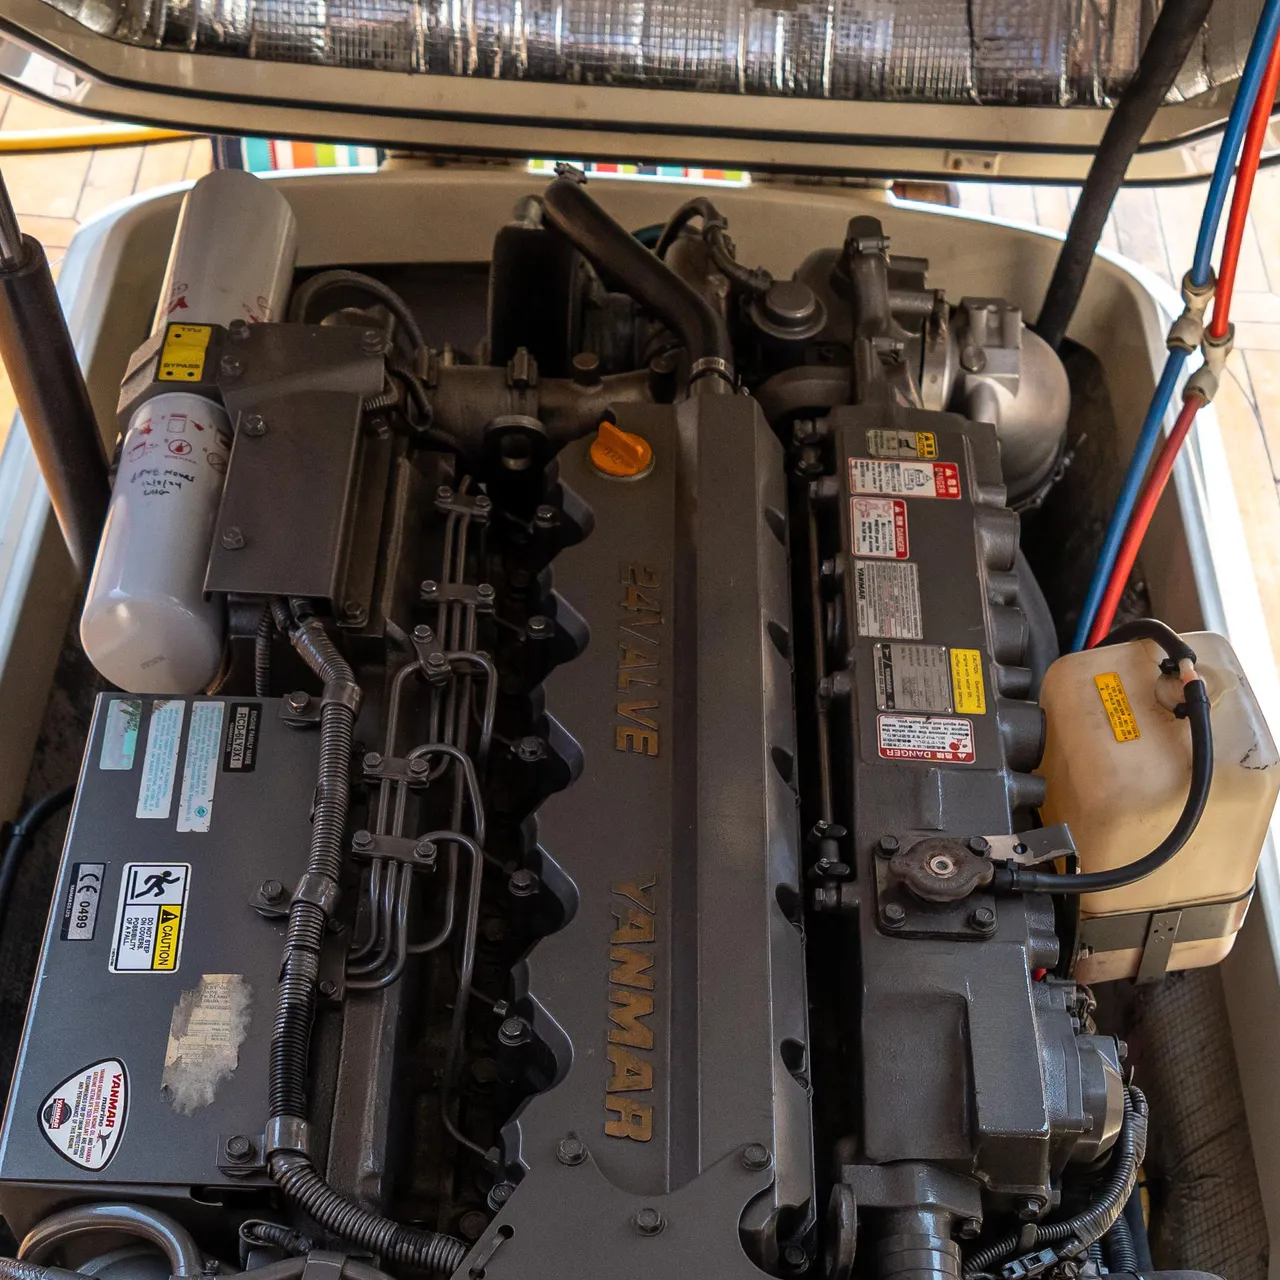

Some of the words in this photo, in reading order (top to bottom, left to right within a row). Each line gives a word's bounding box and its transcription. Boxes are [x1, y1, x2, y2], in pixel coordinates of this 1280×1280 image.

[934, 467, 945, 493] DANGER
[895, 527, 905, 552] DANGER
[887, 749, 931, 758] DANGER
[75, 901, 90, 928] 0499
[125, 917, 132, 925] OF
[122, 931, 130, 945] FALL.
[128, 917, 139, 950] POSSIBILITY
[136, 926, 145, 950] COVERS.
[157, 925, 173, 965] CAUTION
[604, 875, 658, 1143] YANMAR
[81, 1075, 91, 1103] RECOMMENDED
[105, 1073, 122, 1127] YANMAR
[52, 1099, 63, 1128] YANMAR
[72, 1090, 82, 1117] PERFORMANCE
[98, 1096, 107, 1127] marine
[77, 1112, 85, 1130] OPTIMUM
[82, 1118, 91, 1135] COOLANT
[72, 1131, 81, 1155] PROTECTION
